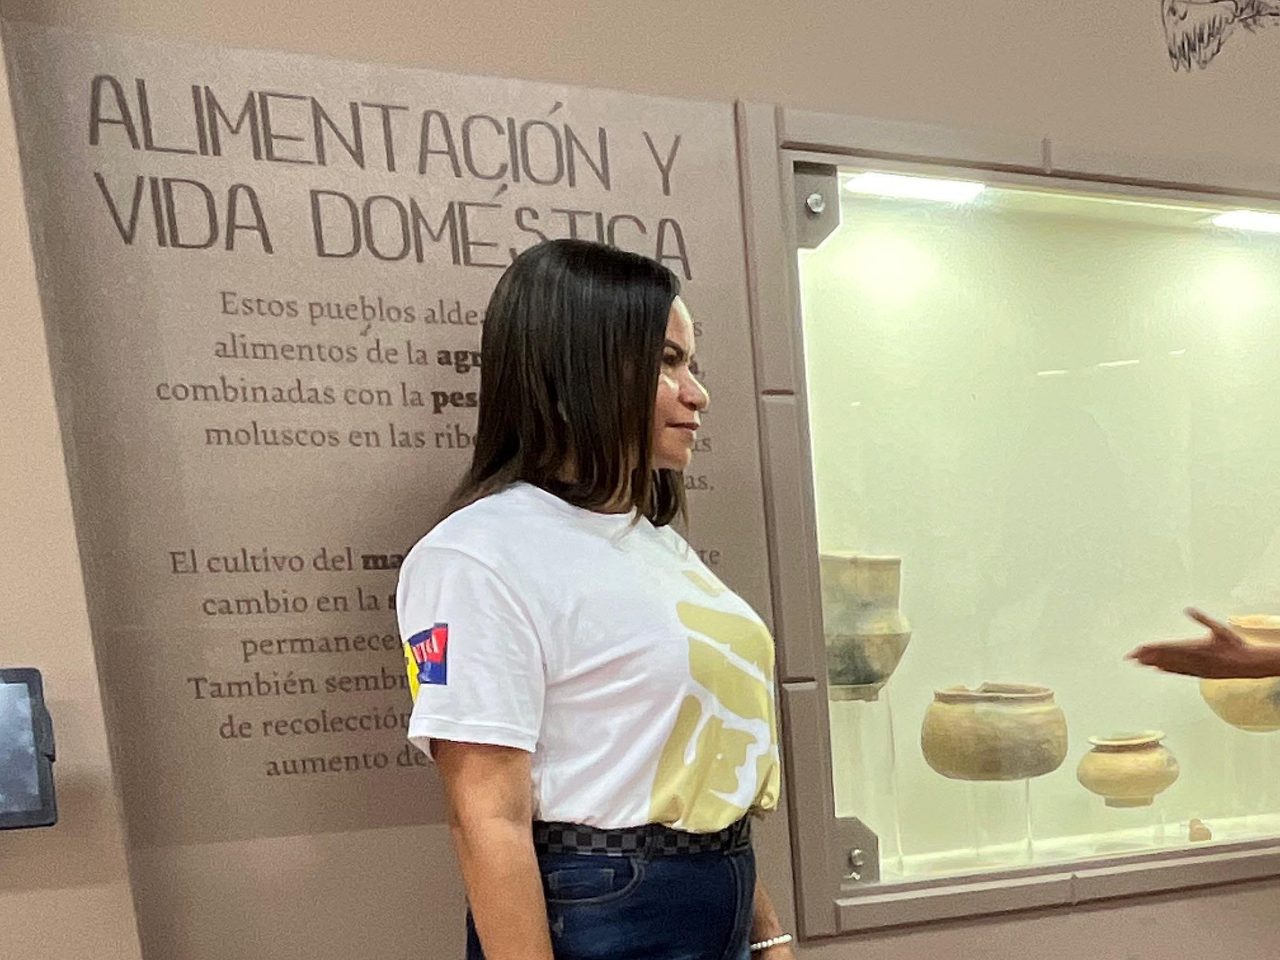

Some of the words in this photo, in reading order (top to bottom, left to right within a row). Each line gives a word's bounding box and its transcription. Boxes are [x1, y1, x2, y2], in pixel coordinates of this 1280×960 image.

[89, 74, 612, 191] ALIMENTACIÓN
[642, 130, 682, 196] Y
[93, 171, 274, 255] VIDA
[219, 291, 299, 318] Estos
[308, 295, 416, 326] pueblos
[423, 299, 486, 326] alde
[214, 331, 358, 364] alimentos
[366, 338, 399, 365] de
[406, 340, 429, 366] la
[156, 375, 336, 405] combinadas
[343, 386, 393, 406] con
[401, 381, 424, 407] la
[431, 390, 478, 414] pes
[204, 420, 340, 447] moluscos
[348, 429, 381, 448] en
[389, 422, 426, 449] las
[170, 549, 199, 574] El
[206, 548, 305, 574] cultivo
[312, 546, 354, 573] del
[202, 590, 308, 617] cambio
[316, 595, 349, 613] en
[357, 587, 381, 612] la
[241, 634, 405, 663] permanece
[187, 671, 316, 701] También
[219, 714, 252, 740] de
[266, 751, 390, 777] aumento
